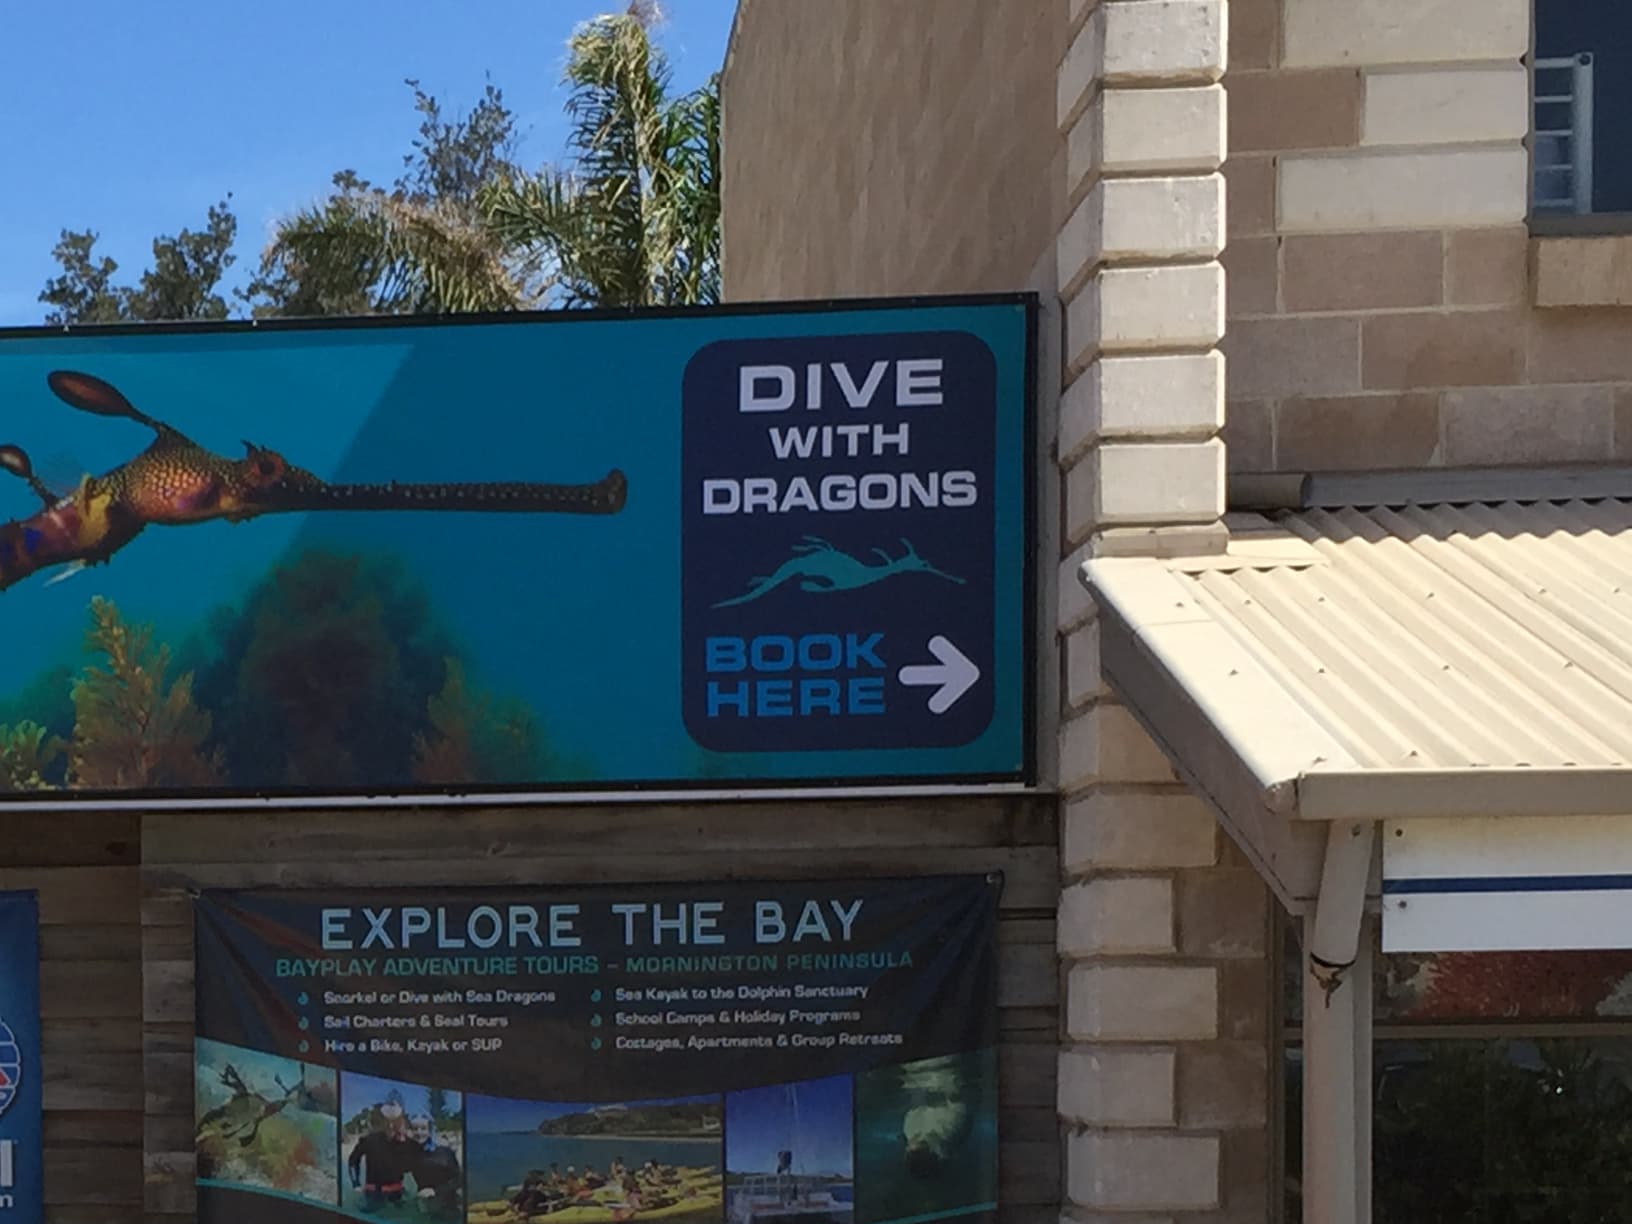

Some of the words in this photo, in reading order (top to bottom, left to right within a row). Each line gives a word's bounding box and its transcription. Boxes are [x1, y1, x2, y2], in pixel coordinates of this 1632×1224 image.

[739, 359, 943, 413] DIVE
[769, 422, 909, 459] WITH
[703, 470, 978, 514] DRAGONS
[705, 633, 887, 673] BOOK
[706, 677, 886, 718] HERE
[320, 904, 582, 950] EXPLORE
[611, 901, 726, 946] THE
[755, 899, 864, 944] BAY
[275, 958, 377, 977] BAYPLAY
[382, 957, 518, 976] ADVENTURE
[526, 955, 599, 974] TOURS
[625, 954, 778, 973] MORNINGTON
[786, 951, 913, 970] PENINSULA
[324, 990, 377, 1005] Snorkel
[380, 994, 396, 1005] or
[399, 991, 429, 1004] Dive
[432, 990, 463, 1003] with
[466, 990, 493, 1003] Sea
[495, 989, 556, 1005] Dragons
[615, 987, 643, 1001] Sea
[646, 987, 689, 1002] Kayak
[691, 987, 708, 1000] to
[710, 987, 735, 1000] the
[737, 985, 791, 1001] Dolphin
[794, 984, 870, 1000] Sanctuary
[353, 1015, 417, 1028] Charters
[419, 1014, 431, 1027] &
[467, 1014, 509, 1027] Tours
[615, 1011, 663, 1026] School
[666, 1011, 715, 1027] Camps
[719, 1011, 731, 1024] &
[734, 1009, 786, 1026] Holiday
[789, 1009, 861, 1026] Programs
[324, 1038, 355, 1052] Hire
[358, 1042, 366, 1052] a
[370, 1039, 405, 1053] Bike,
[407, 1038, 449, 1055] Kayak
[452, 1041, 468, 1051] or
[471, 1038, 503, 1051] SUP
[687, 1034, 774, 1052] Apartments
[776, 1034, 788, 1047] &
[791, 1033, 836, 1049] Group
[838, 1032, 904, 1047] Retreats
